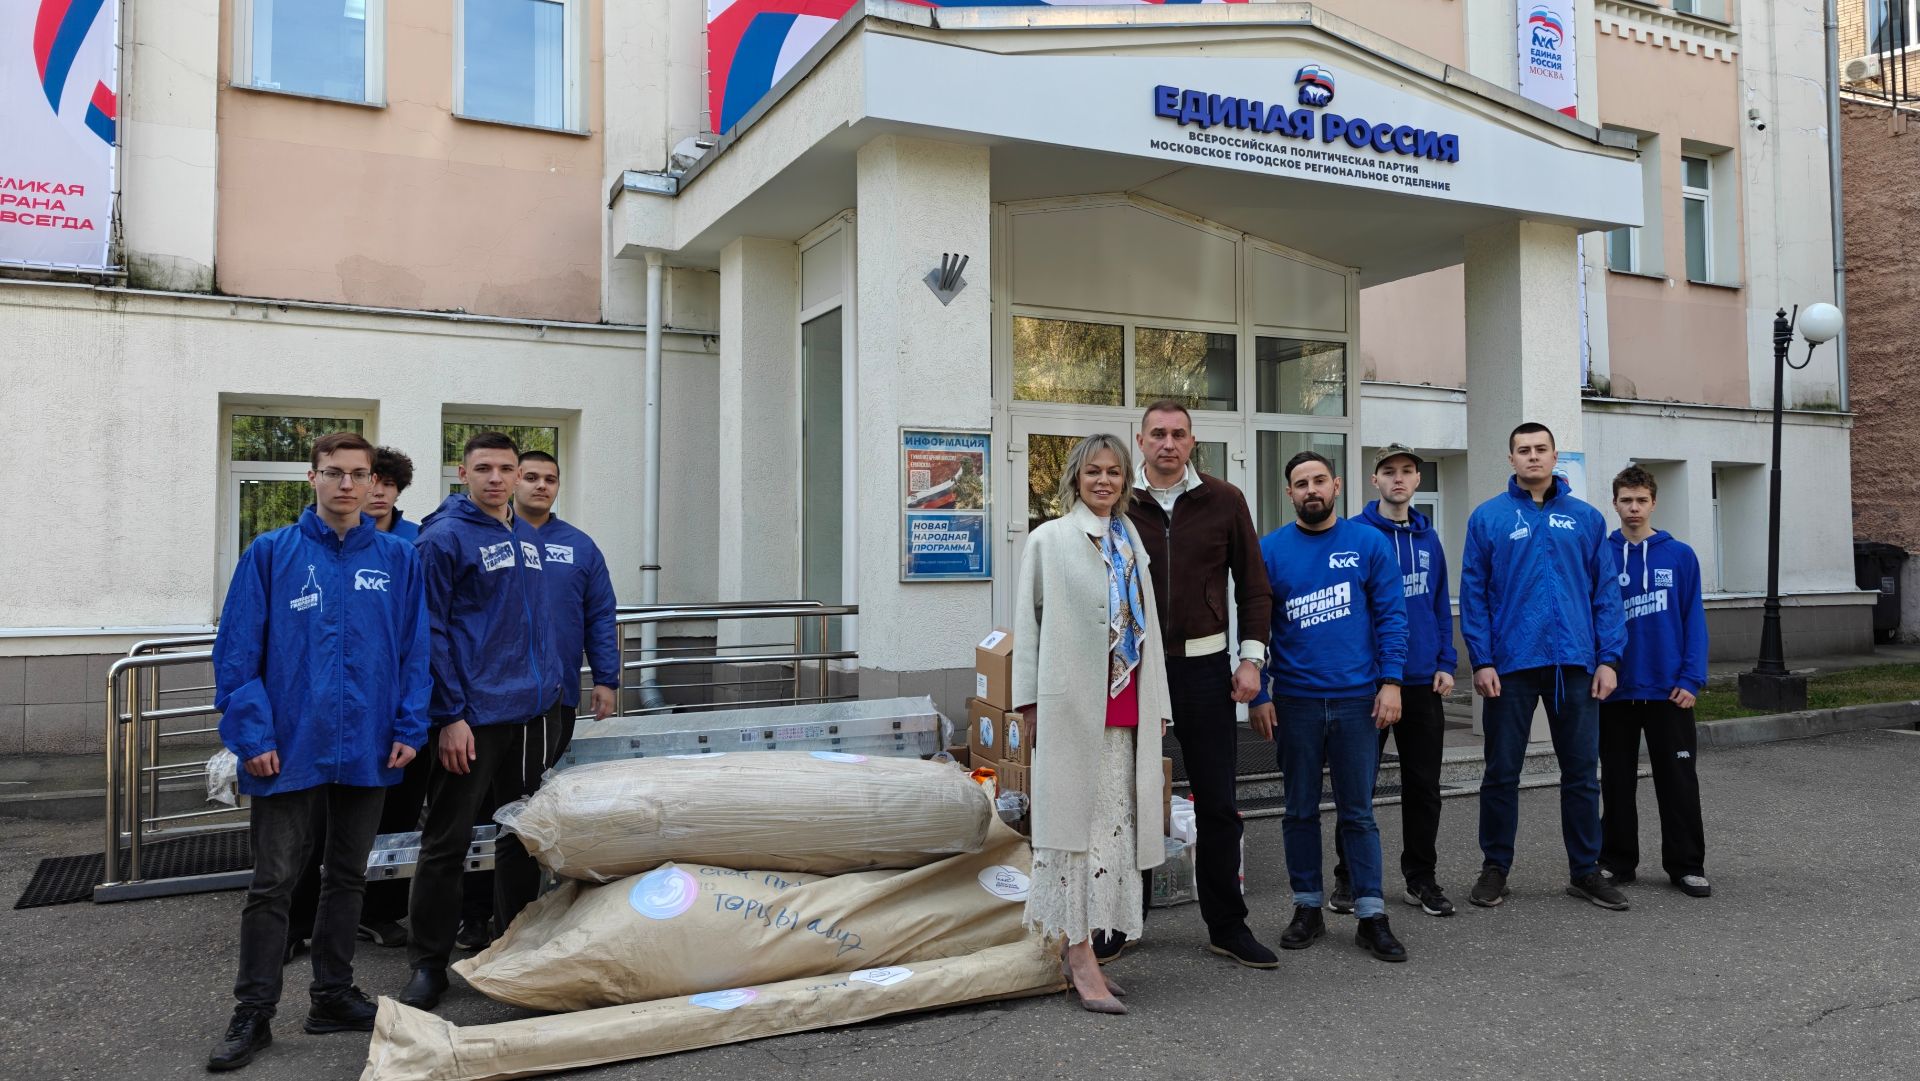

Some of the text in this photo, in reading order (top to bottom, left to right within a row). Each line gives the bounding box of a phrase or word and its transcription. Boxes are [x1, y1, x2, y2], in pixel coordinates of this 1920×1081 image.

[1530, 48, 1562, 61] ЕДИНАЯ
[1530, 57, 1562, 70] РОССИЯ
[1529, 66, 1564, 80] МОСКВА
[1155, 85, 1460, 163] ЕДИНАЯ РОССИЯ
[1189, 131, 1419, 175] ВСЕРОССИЙСКАЯ ПОЛИТИЧЕСКАЯ ПАРТИЯ
[1150, 139, 1451, 191] МОСКОВСКОЕ ГОРОДСКОЕ РЕГИОНАЛЬНОЕ ОТДЕЛЕНИЕ
[0, 176, 84, 197] ЛИКАЯ
[905, 436, 985, 449] ИНФОРМАЦИЯ
[913, 522, 948, 531] НОВАЯ
[913, 533, 968, 542] НАРОДНАЯ
[913, 543, 972, 552] ПРОГРАММА
[1285, 581, 1351, 611] МОЛОДАЯ
[1300, 606, 1352, 630] МОСКВА
